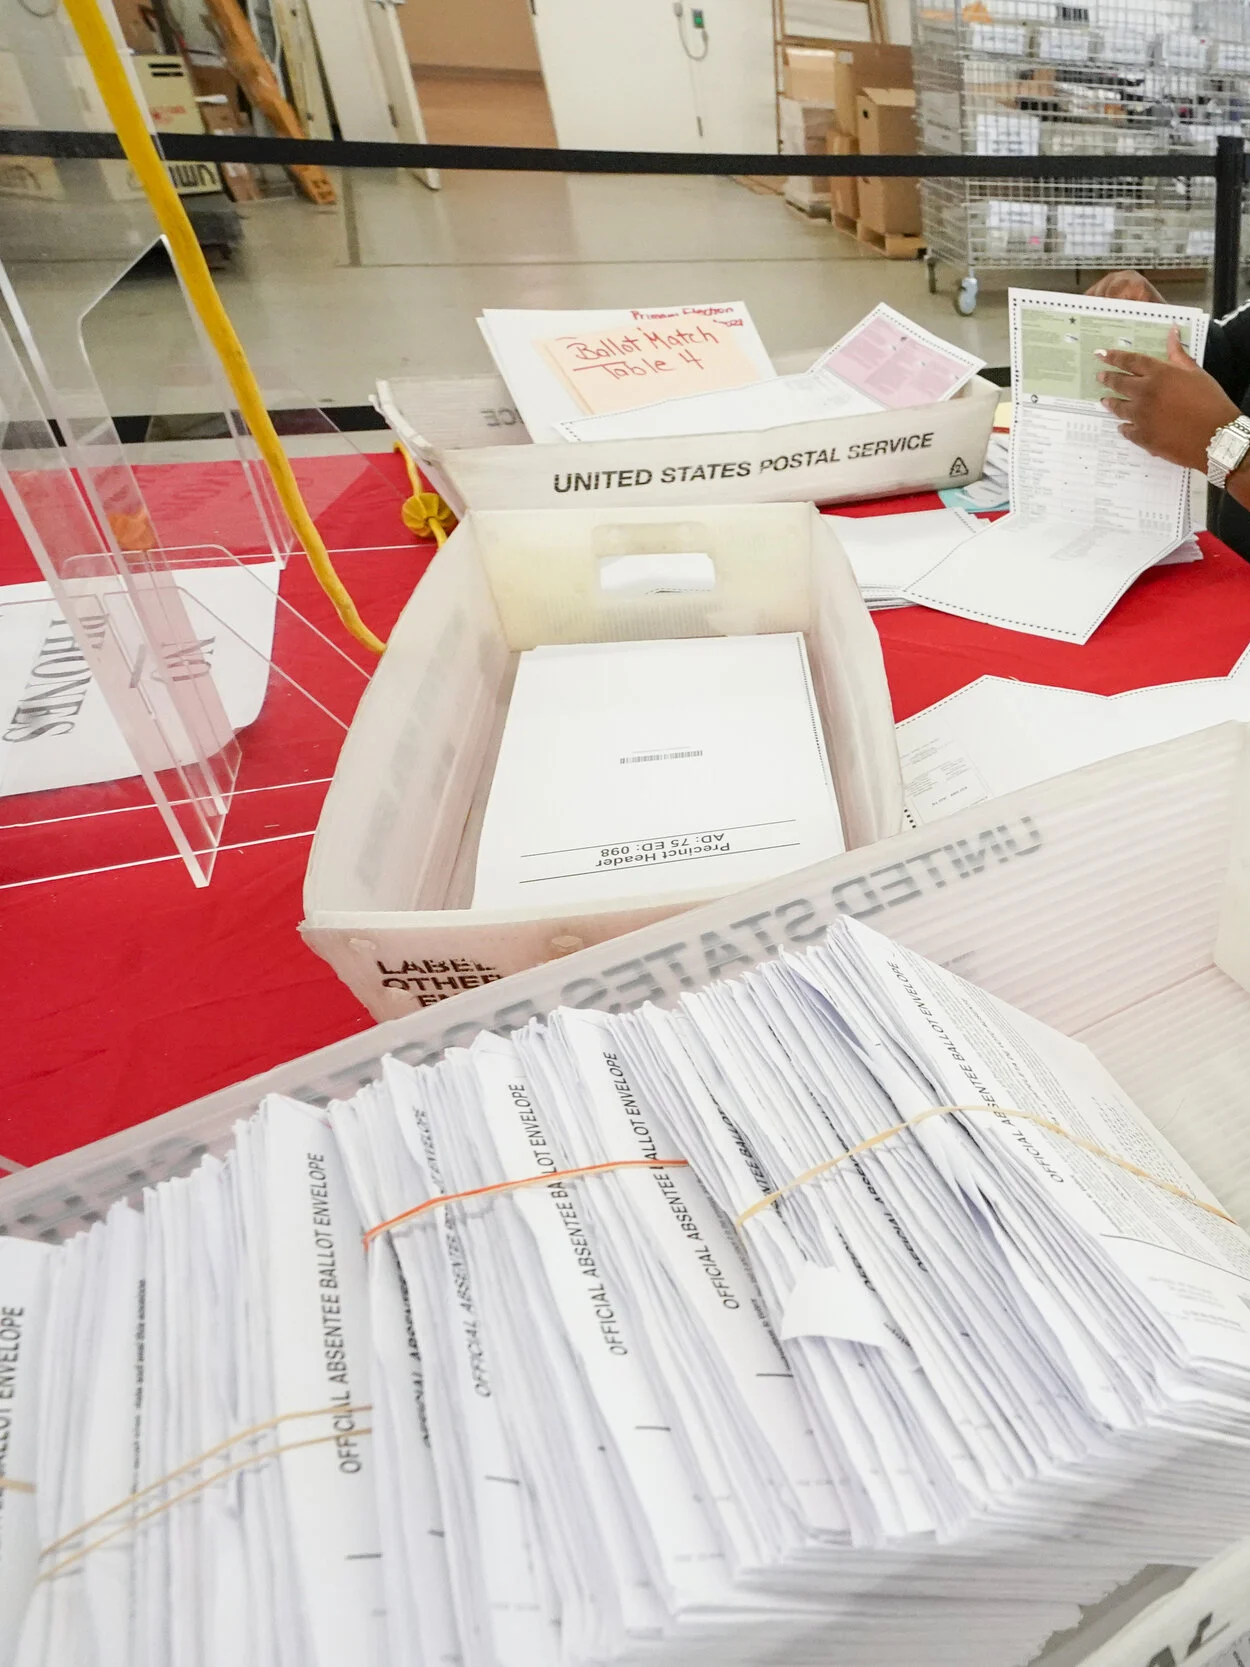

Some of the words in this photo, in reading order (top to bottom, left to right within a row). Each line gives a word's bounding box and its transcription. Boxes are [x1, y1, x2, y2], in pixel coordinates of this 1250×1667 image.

[566, 335, 639, 361] Ballot
[642, 325, 719, 351] Match
[573, 360, 677, 380] Table
[678, 349, 705, 371] 4
[553, 470, 653, 493] UNITED
[660, 462, 752, 484] STATES
[759, 447, 842, 475] POSTAL
[847, 432, 935, 460] SERVICE
[954, 464, 962, 474] 2
[595, 852, 657, 867] Header
[601, 845, 630, 857] 098
[636, 841, 665, 852] ED:
[663, 842, 731, 859] Precinct
[671, 838, 689, 848] 75
[696, 832, 725, 844] AD:
[377, 958, 497, 975] LABEL
[886, 960, 932, 1018] ENVELOPE
[926, 1014, 965, 1062] BALLOT
[603, 1052, 641, 1117] ENVELOPE
[508, 1083, 547, 1147] ENVELOPE
[630, 1118, 665, 1171] ALLOT
[1011, 1130, 1065, 1184] OFFICIAL
[307, 1151, 332, 1227] ENVELOPE
[533, 1150, 569, 1198] BALOT
[653, 1174, 701, 1240] ABSENTEE
[315, 1229, 339, 1290] BALLOT
[555, 1202, 601, 1279] ABSENTEE
[698, 1245, 740, 1310] OFFICIAL
[319, 1293, 350, 1385] ABSENTEE
[588, 1283, 629, 1356] OFFICIAL
